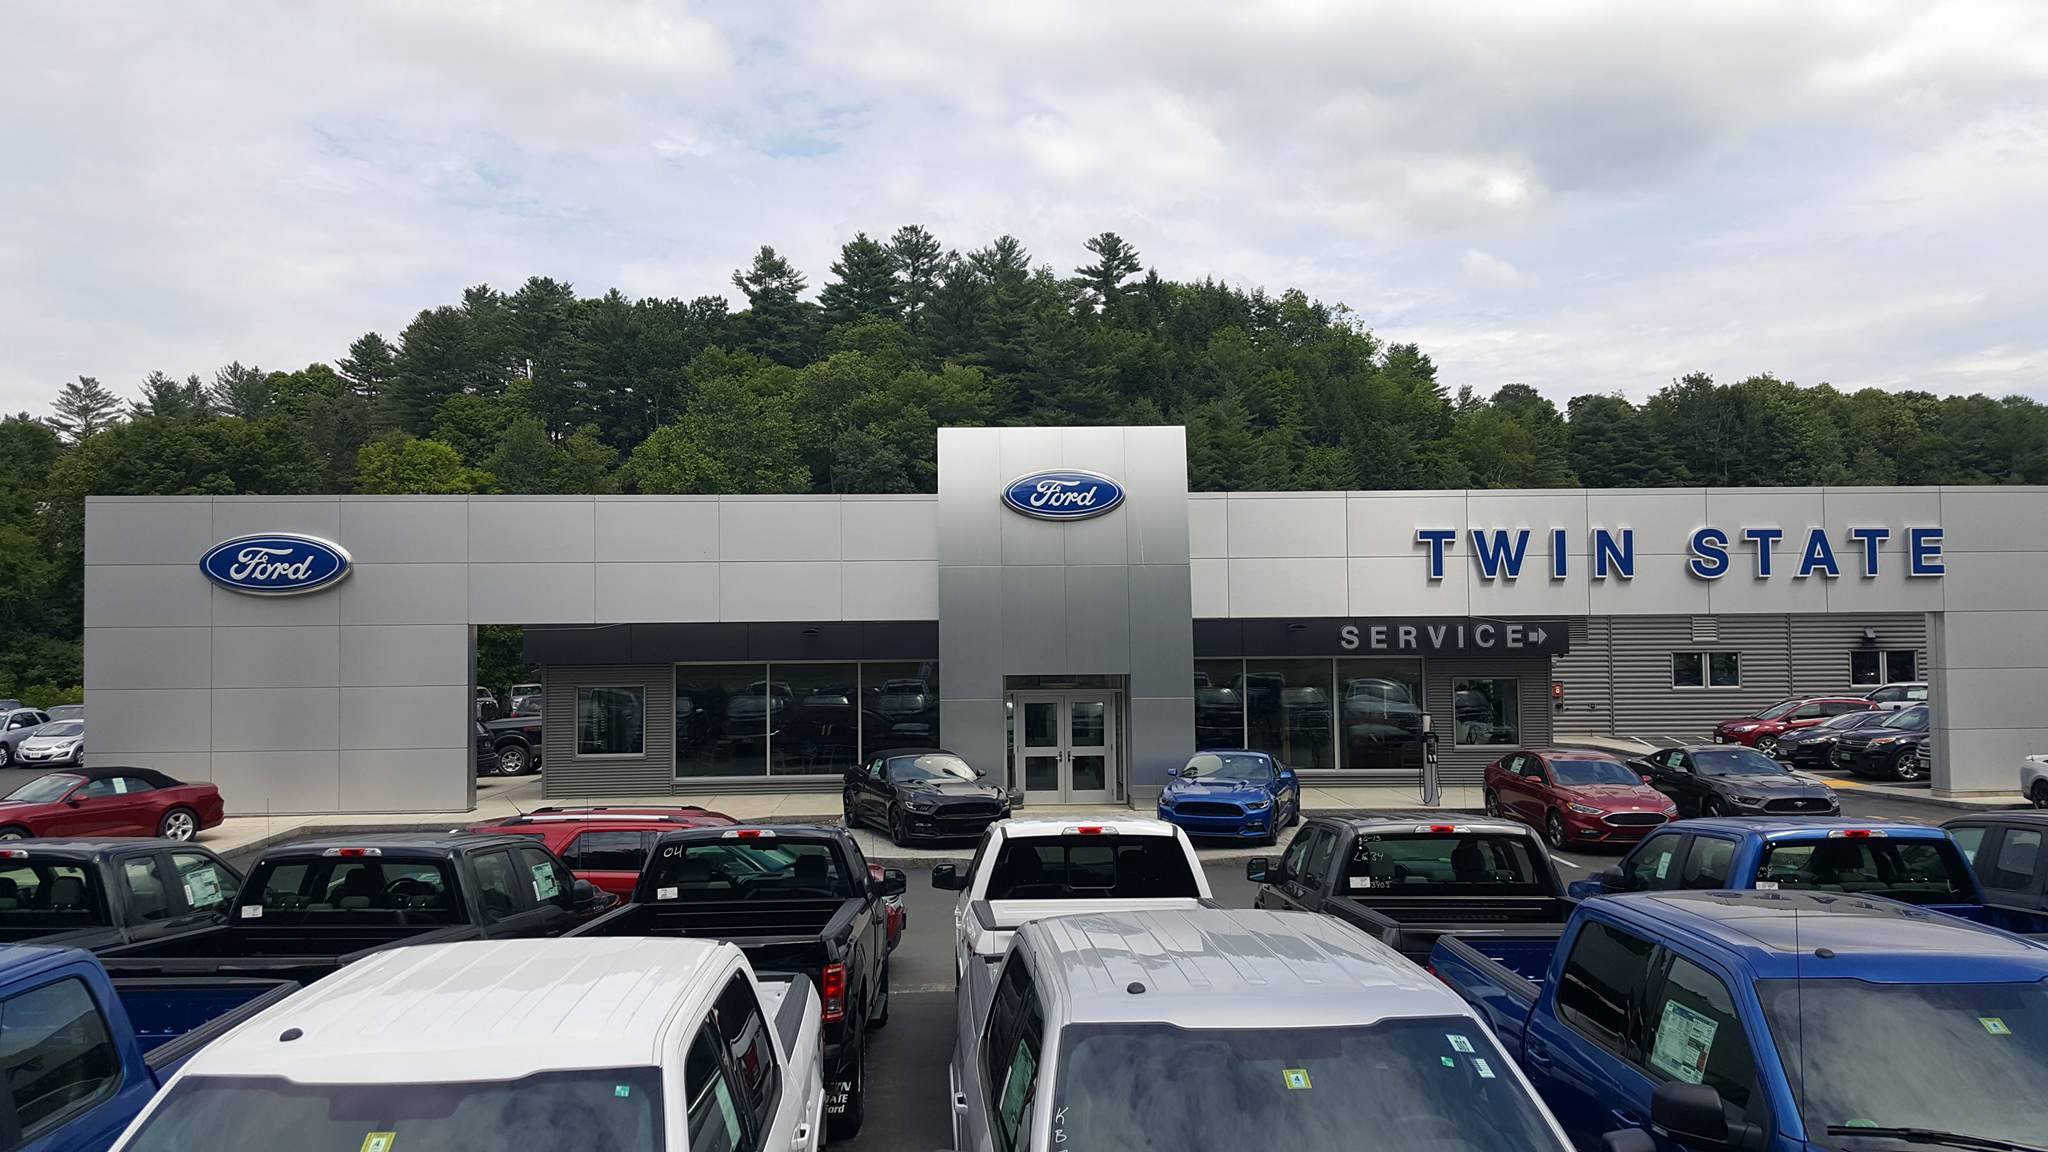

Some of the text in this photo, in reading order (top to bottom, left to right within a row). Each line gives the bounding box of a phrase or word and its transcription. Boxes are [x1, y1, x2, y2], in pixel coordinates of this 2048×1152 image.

[1030, 479, 1098, 507] Ford
[229, 547, 314, 580] Ford
[1416, 527, 1945, 580] TWIN STATE
[1340, 624, 1524, 649] SERVICE
